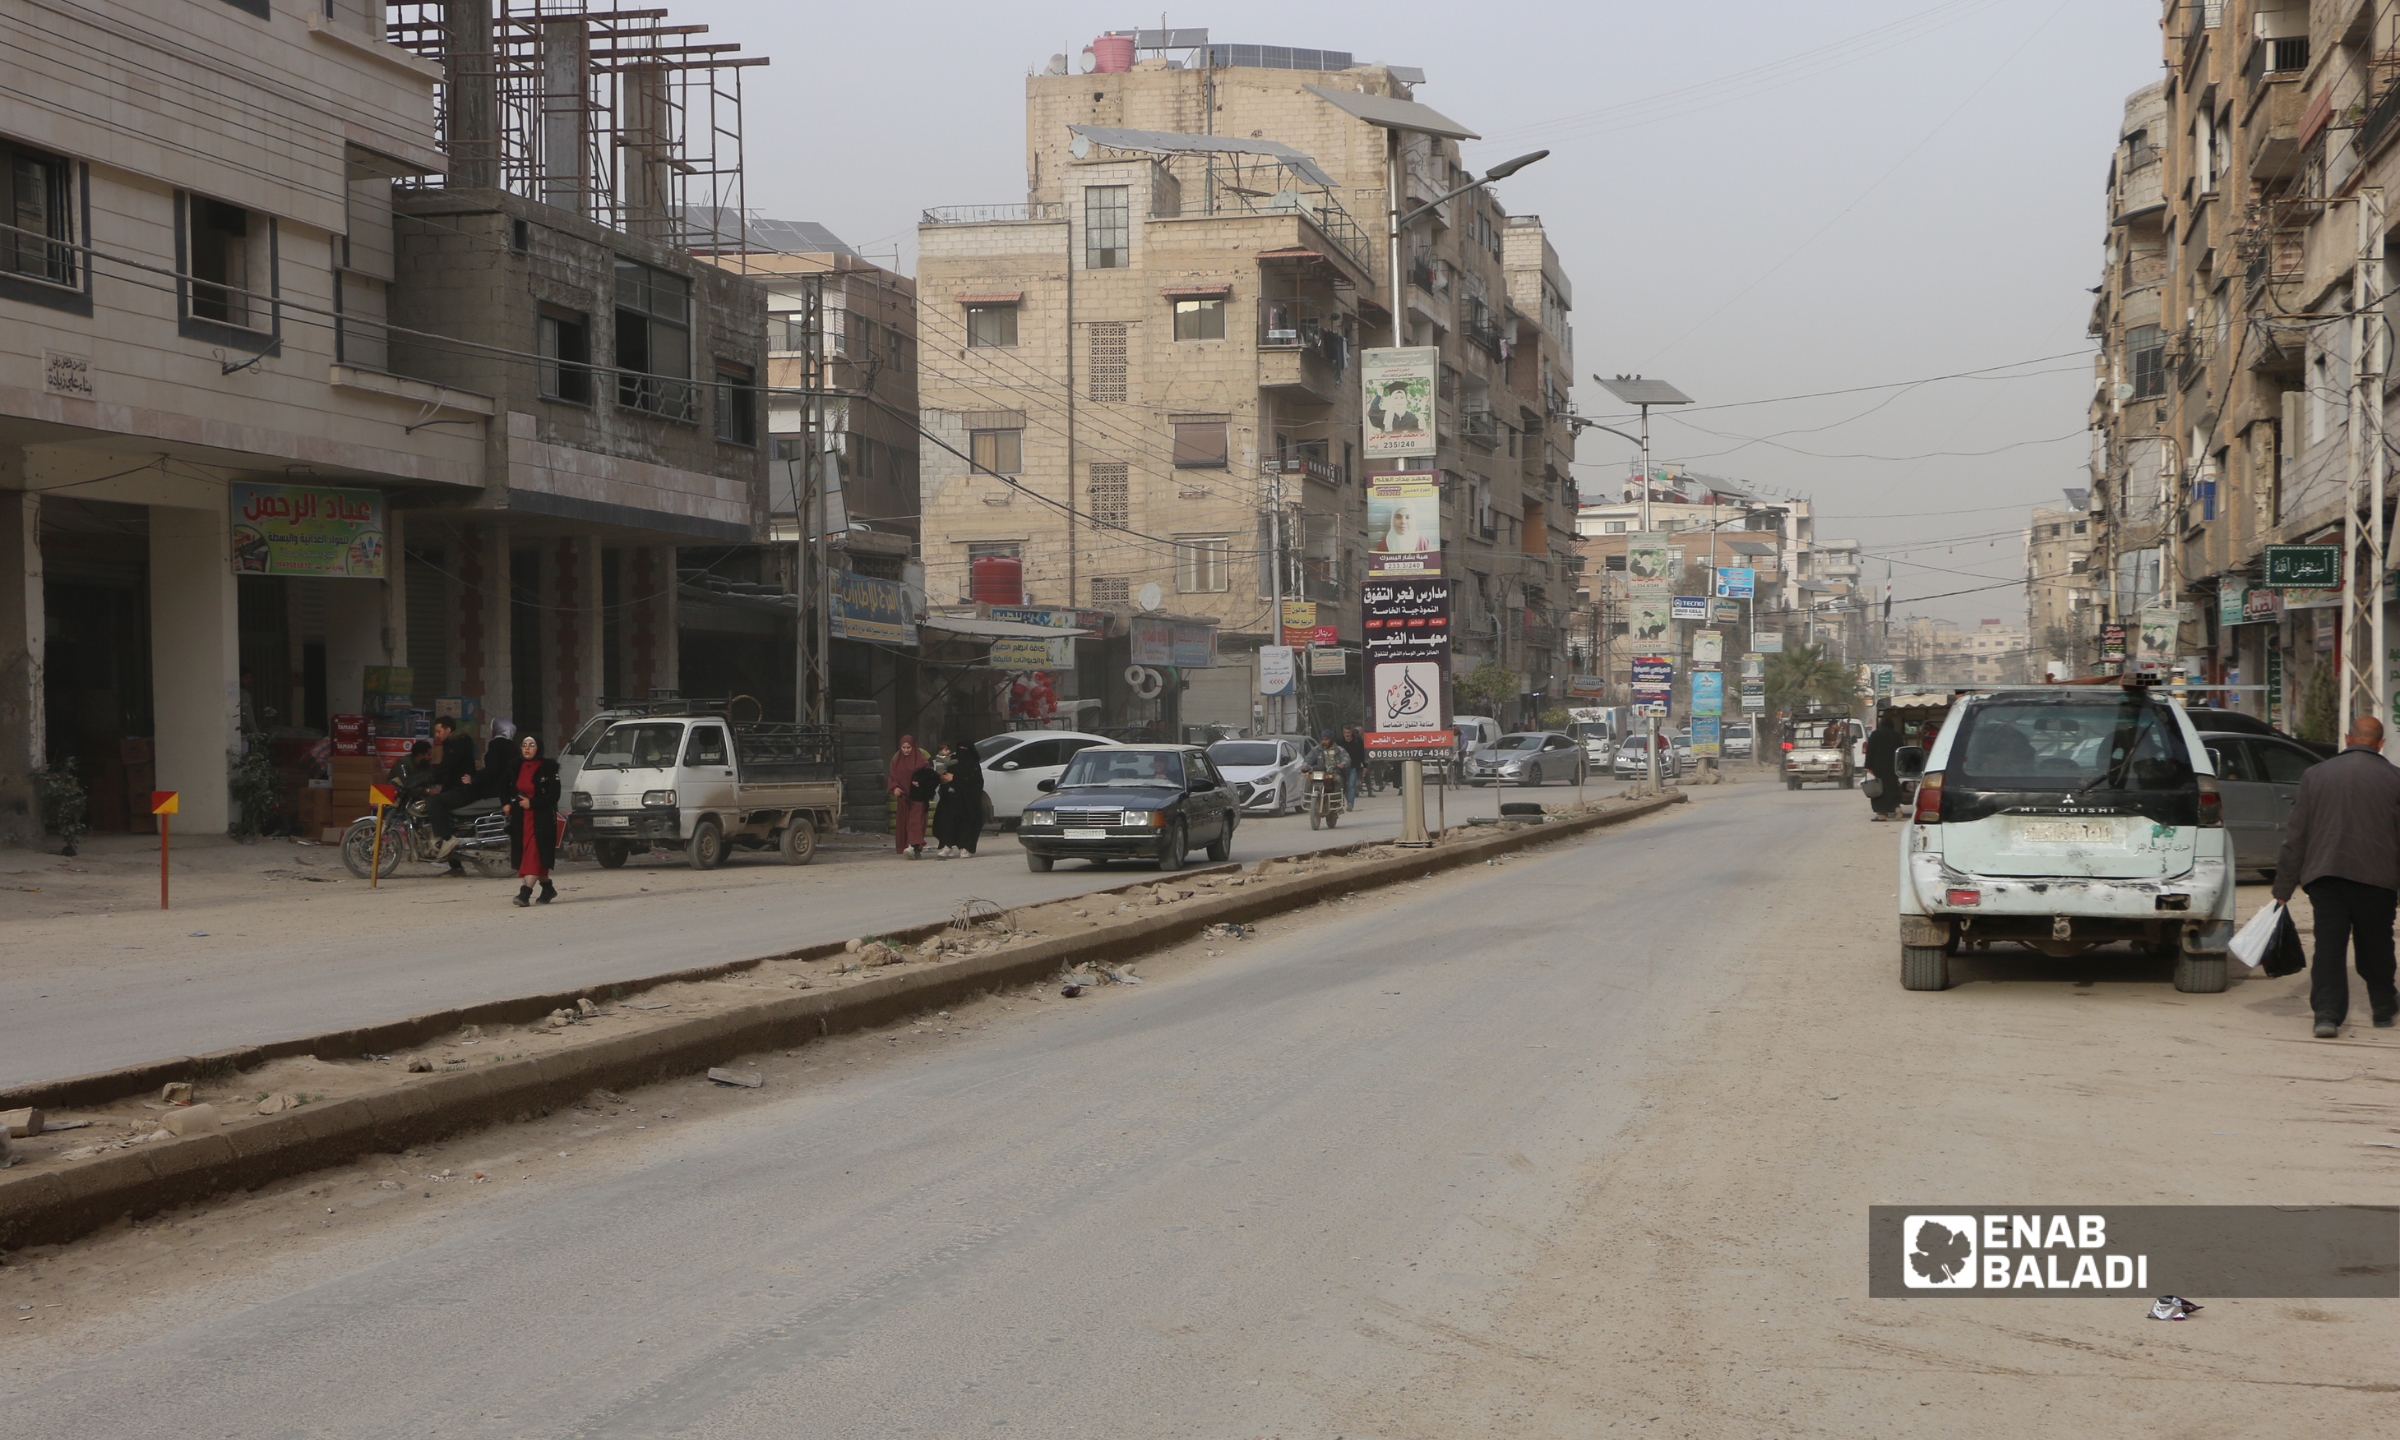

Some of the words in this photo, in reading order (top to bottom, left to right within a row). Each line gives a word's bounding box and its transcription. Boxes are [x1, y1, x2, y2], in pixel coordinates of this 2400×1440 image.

[1383, 441, 1415, 449] 235/240
[242, 491, 318, 526] الرحمن
[325, 495, 372, 529] عباد
[301, 532, 328, 545] الغذائية
[328, 534, 349, 547] للمواد
[1394, 586, 1415, 604] فجر
[1416, 586, 1447, 603] مدارس
[1372, 606, 1401, 615] الخاصة
[1402, 605, 1439, 615] النموذجية
[1285, 617, 1300, 625] للحلاقة
[1365, 631, 1407, 649] الفجر
[1408, 633, 1447, 647] معهد
[1370, 736, 1391, 745] الفجر
[1406, 736, 1427, 744] القطر
[1377, 749, 1450, 757] 0988311176-4346
